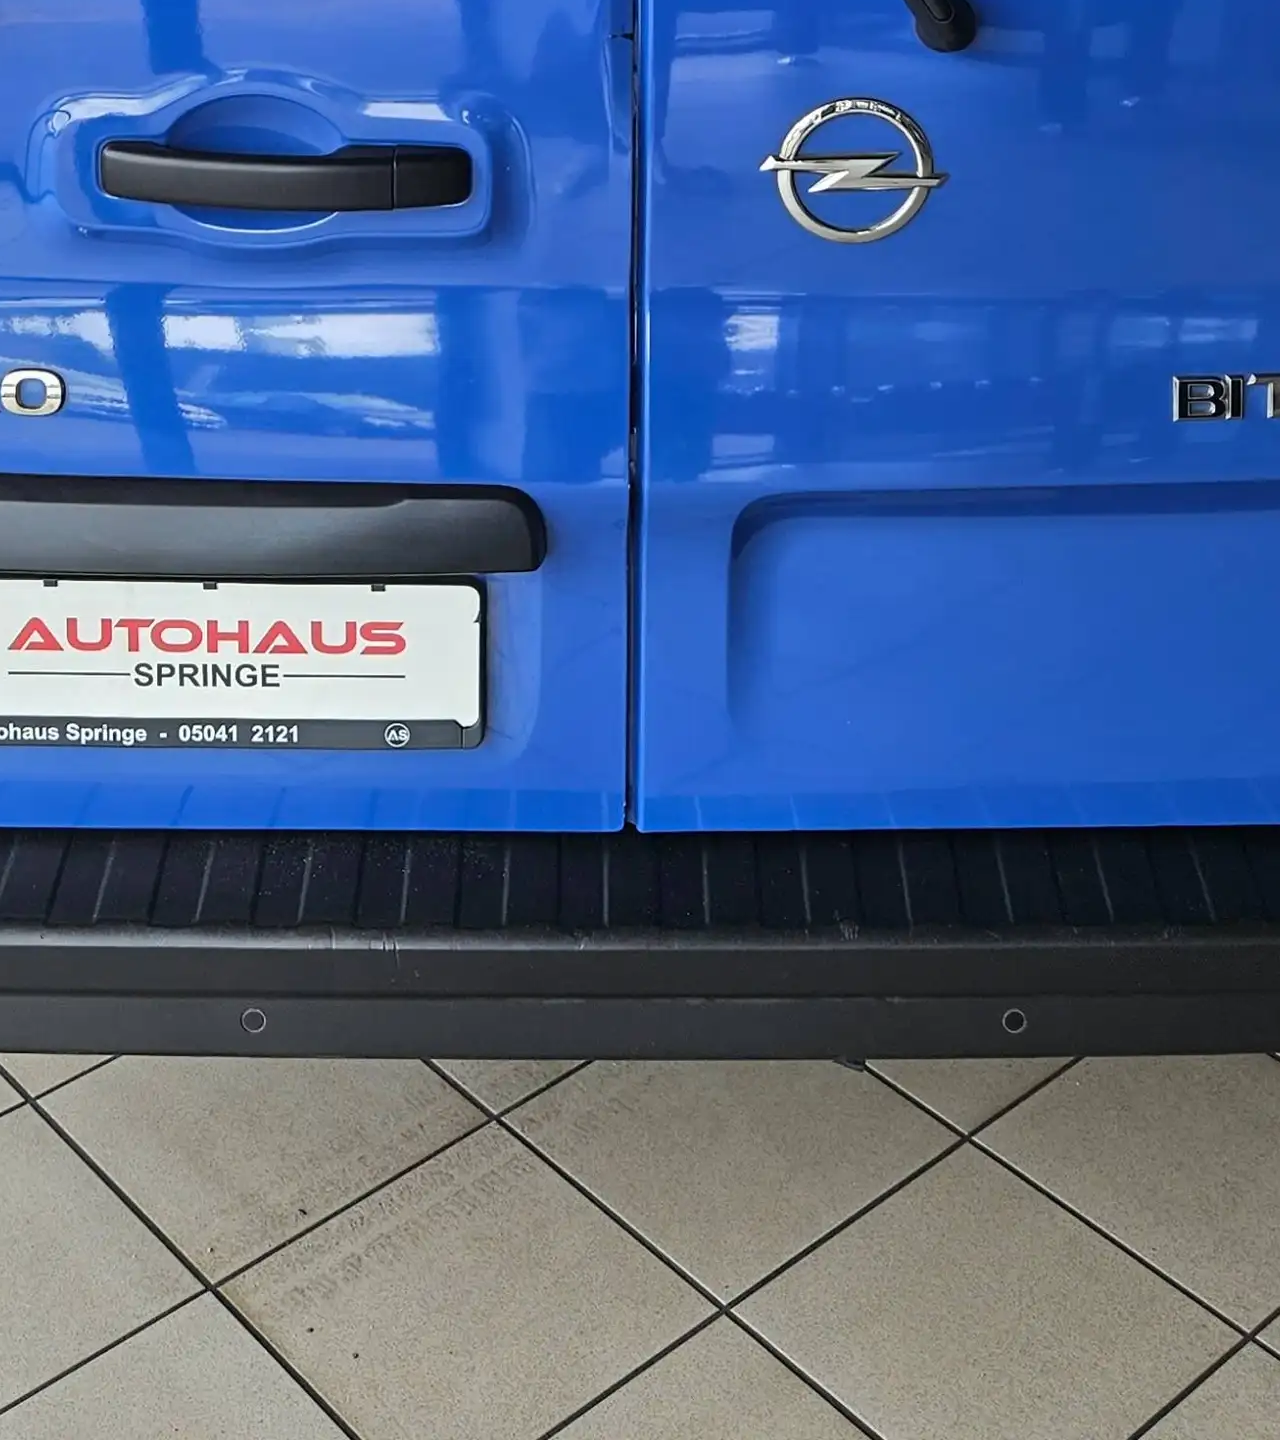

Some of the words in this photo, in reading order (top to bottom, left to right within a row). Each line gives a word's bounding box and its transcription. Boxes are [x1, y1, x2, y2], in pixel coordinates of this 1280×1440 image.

[7, 616, 407, 656] AUTOHAUS
[133, 662, 281, 688] SPRINGE
[65, 723, 148, 746] Springe
[178, 724, 238, 742] 05041
[251, 724, 299, 743] 2121
